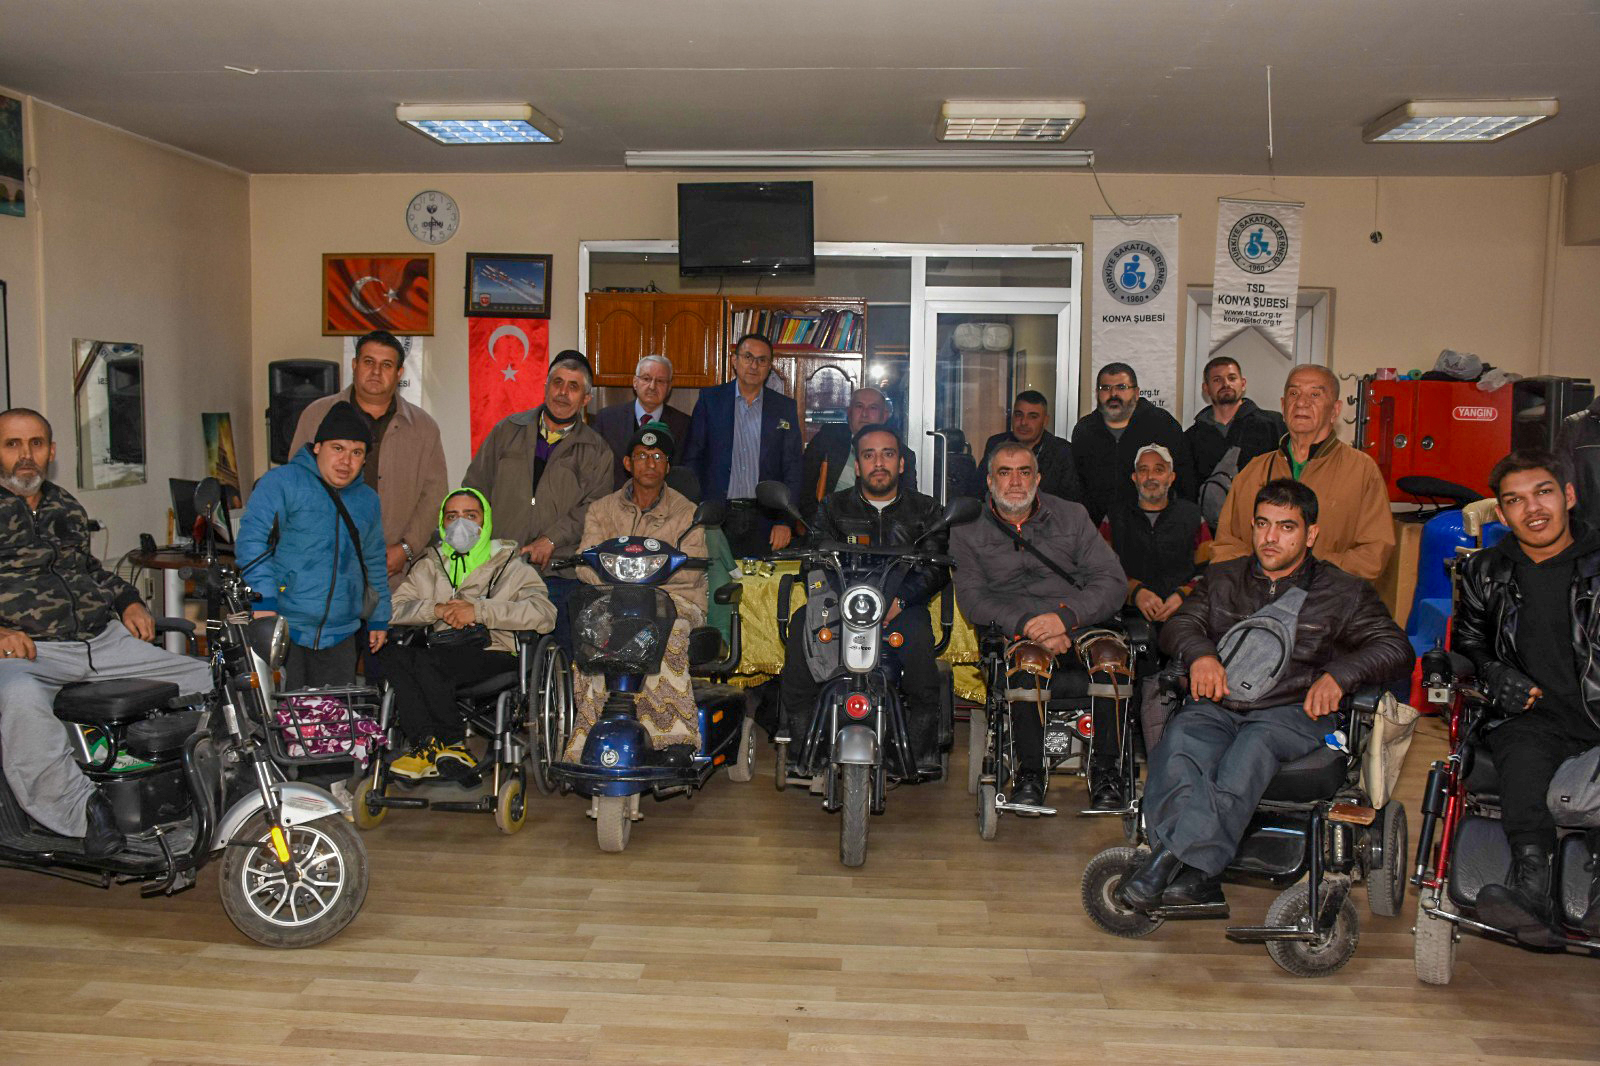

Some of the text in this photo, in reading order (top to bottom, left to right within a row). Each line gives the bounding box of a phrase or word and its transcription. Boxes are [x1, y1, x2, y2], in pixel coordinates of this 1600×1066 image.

[1239, 216, 1278, 230] SAKATLAR
[1106, 244, 1165, 294] TÜRKİYE SAKATLAR DERNEĞİ
[1247, 283, 1265, 293] TSD
[1218, 295, 1289, 308] KONYA ŞUBESİ
[1134, 313, 1165, 324] ŞUBESİ
[1224, 310, 1282, 319] www.tsd.org.tr
[1224, 316, 1282, 326] konya@tsd.org.tr
[1140, 389, 1160, 397] org.tr
[1458, 408, 1492, 417] YANGIN
